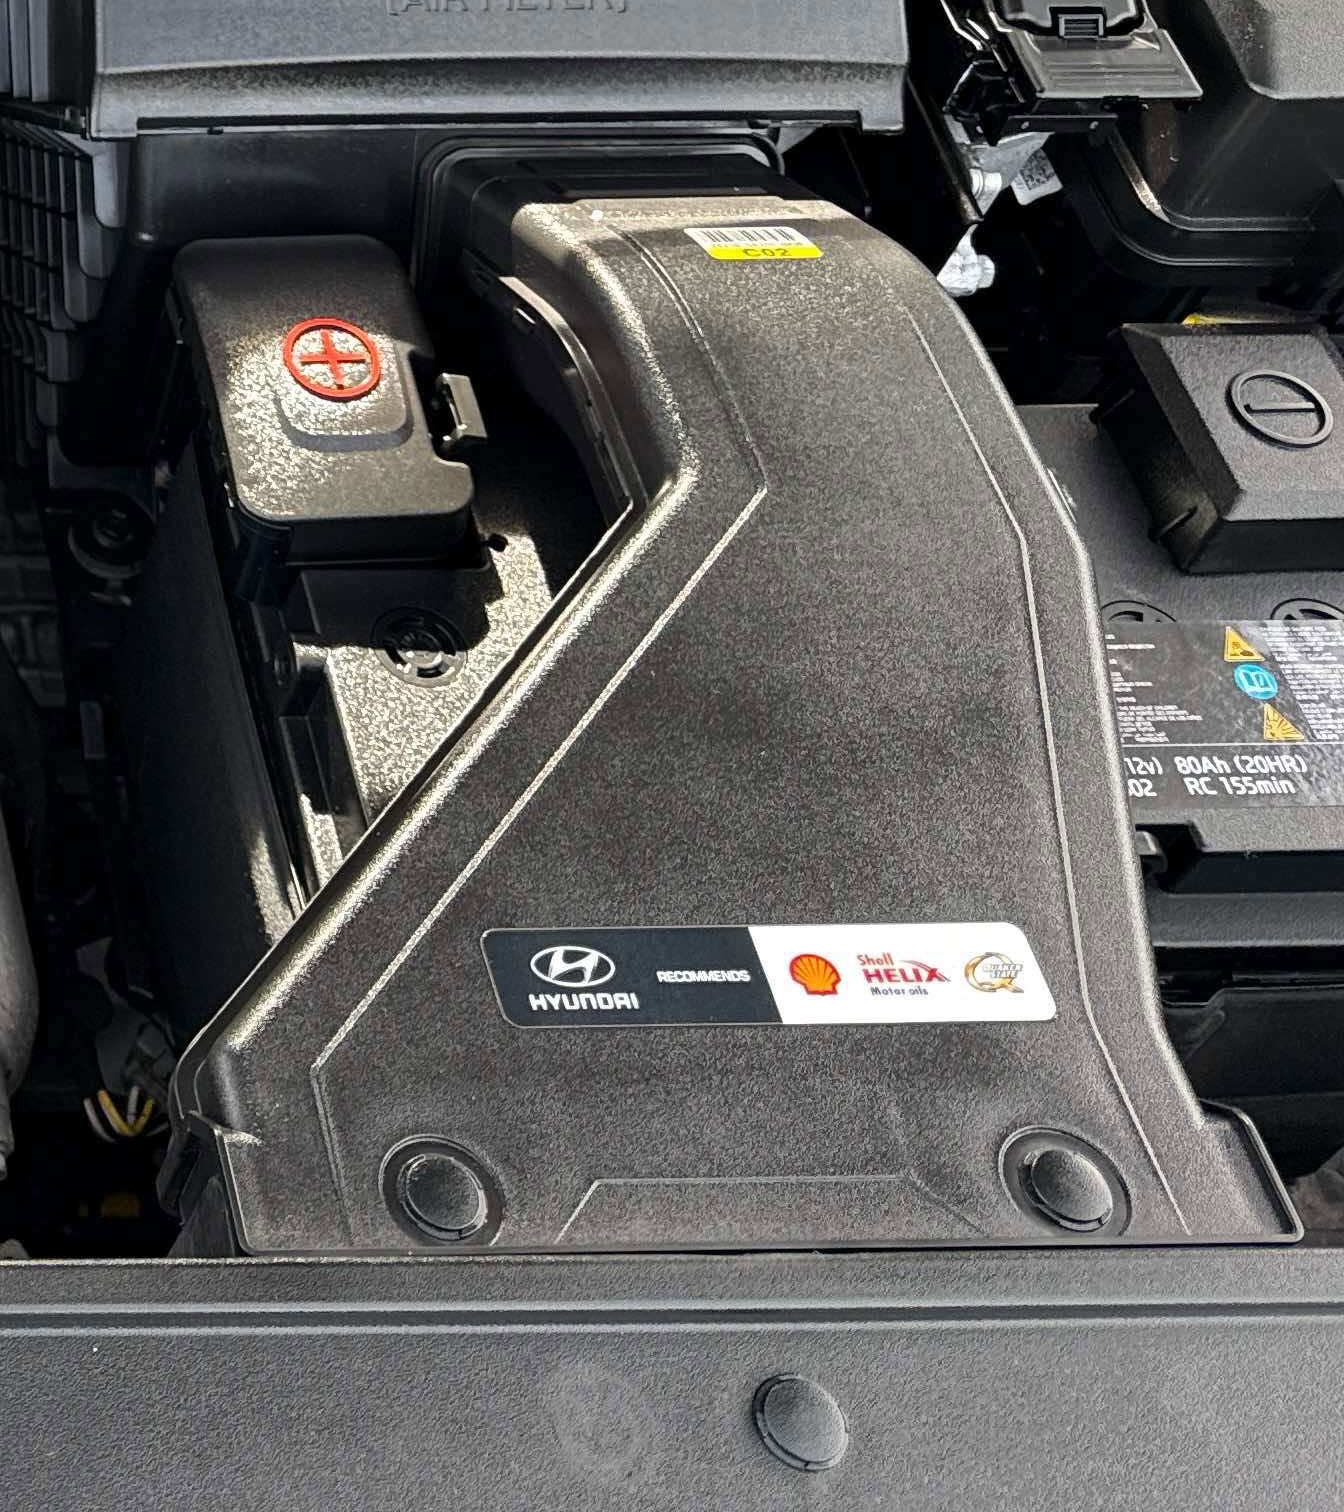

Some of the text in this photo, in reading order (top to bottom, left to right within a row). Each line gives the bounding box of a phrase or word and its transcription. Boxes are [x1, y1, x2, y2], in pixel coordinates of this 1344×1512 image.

[1173, 755, 1232, 775] 80Ah
[1233, 754, 1309, 774] (20HR)
[1128, 776, 1297, 797] 02 RC 155min
[656, 969, 751, 984] RECOMMENDS
[862, 967, 947, 984] HELIX
[870, 986, 906, 996] Motor
[528, 992, 640, 1011] HYUNDAI
